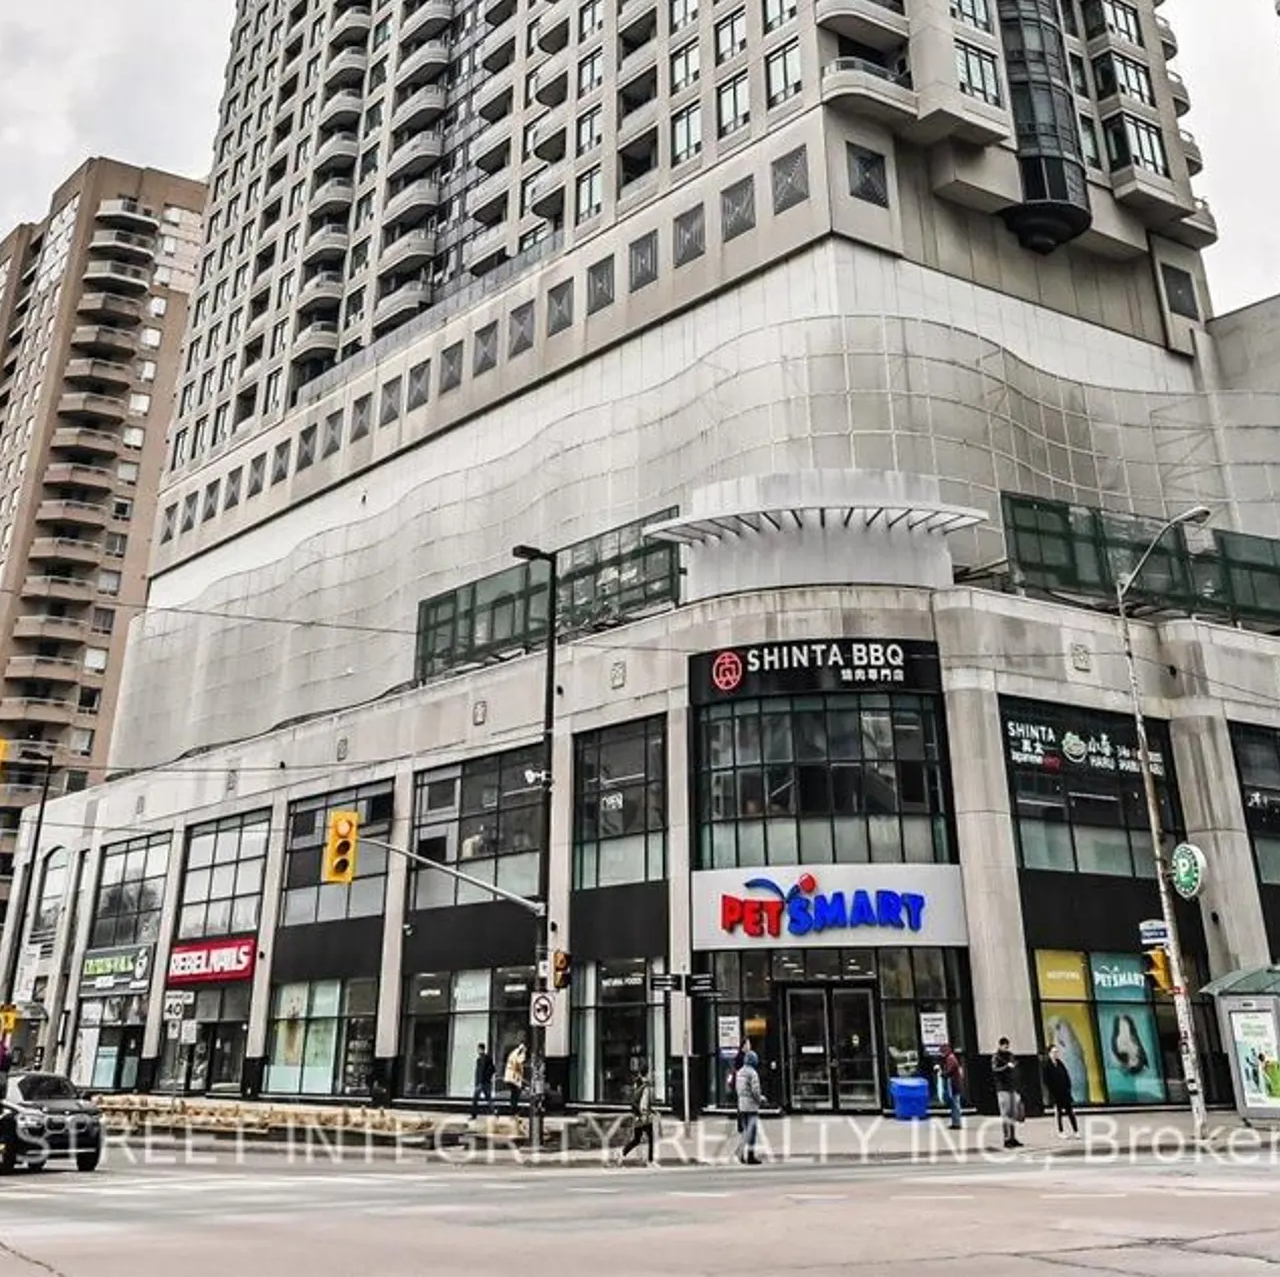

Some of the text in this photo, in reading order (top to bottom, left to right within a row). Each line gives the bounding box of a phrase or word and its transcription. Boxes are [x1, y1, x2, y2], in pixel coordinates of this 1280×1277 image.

[747, 643, 904, 671] SHINTA BBQ
[1007, 722, 1056, 743] SHINTA
[721, 890, 926, 938] PETSMART
[166, 1002, 183, 1016] 40
